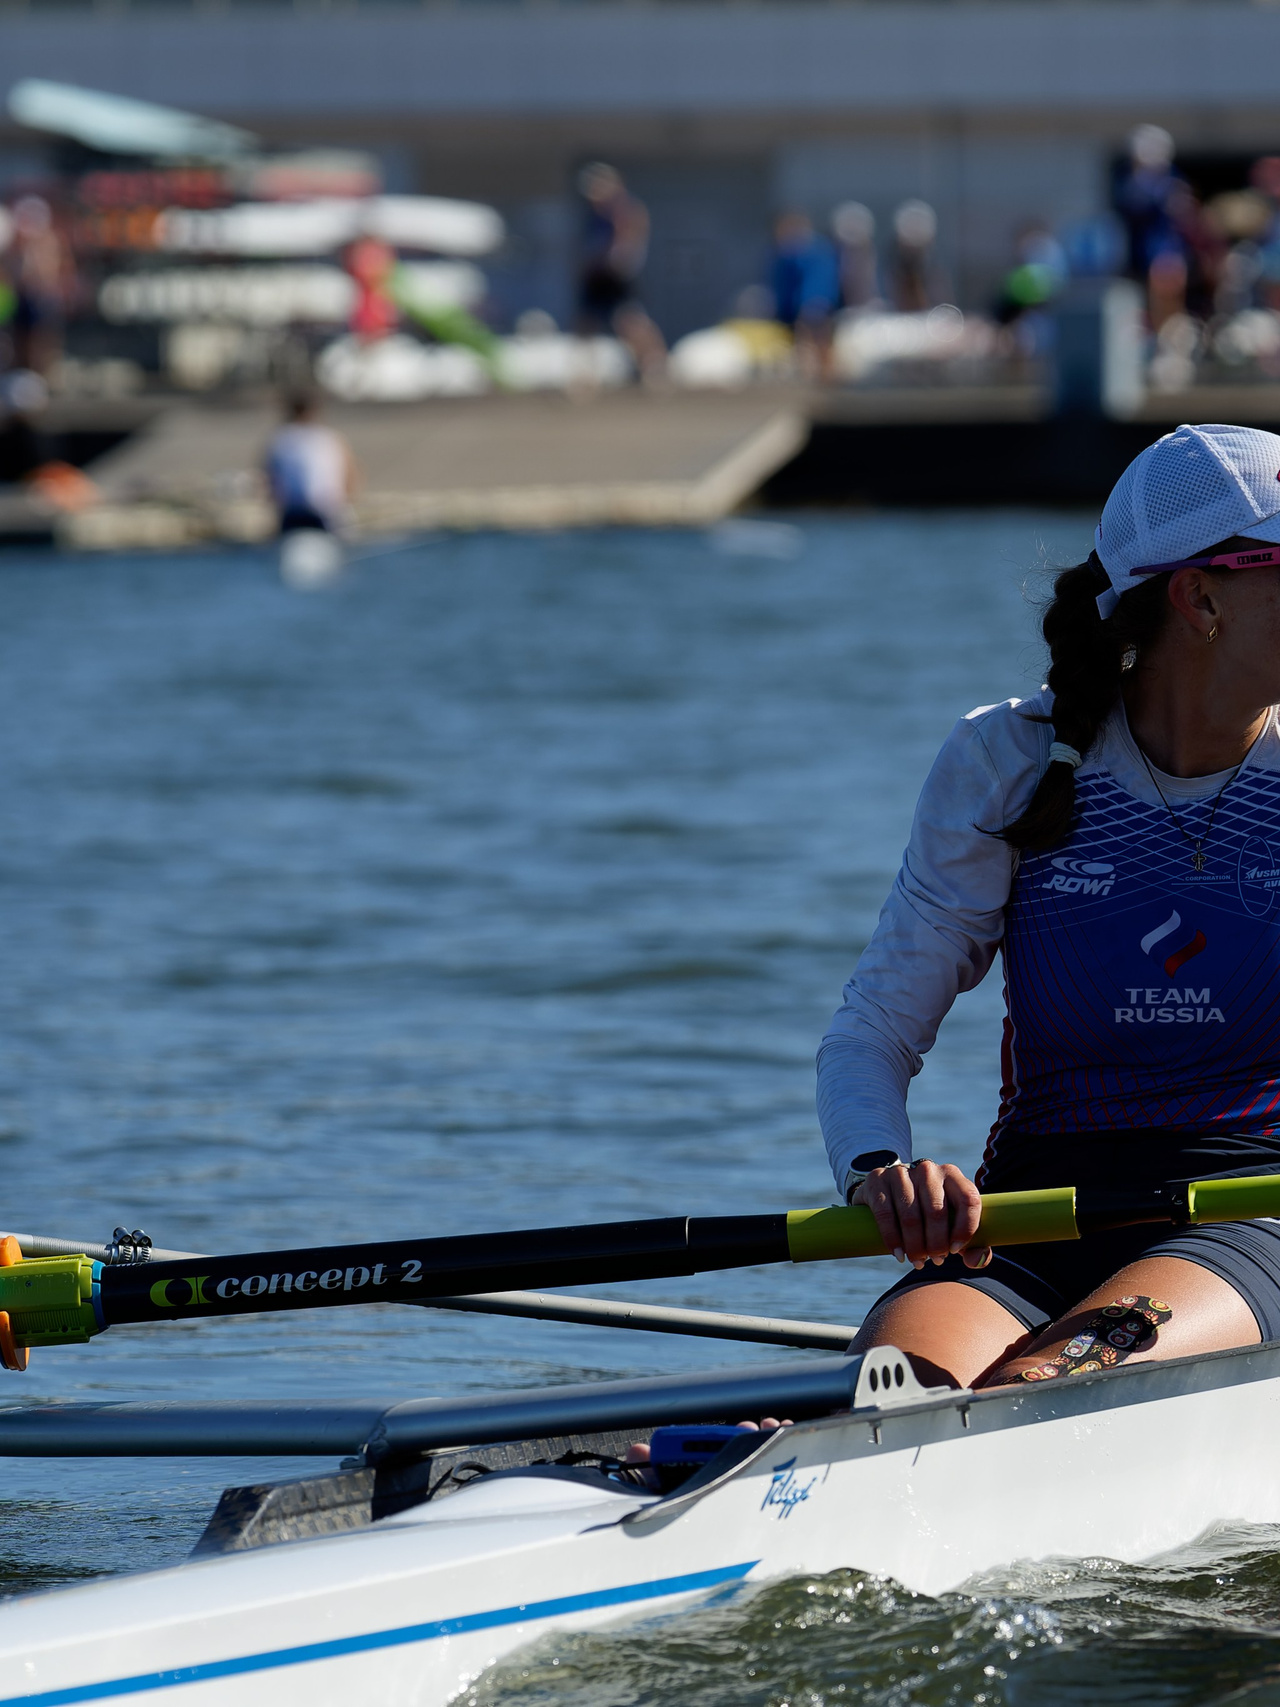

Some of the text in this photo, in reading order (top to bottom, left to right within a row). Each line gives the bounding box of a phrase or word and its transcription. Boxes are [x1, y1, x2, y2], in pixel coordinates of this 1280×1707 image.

[1125, 988, 1210, 1004] TEAM
[1114, 1007, 1226, 1023] RUSSIA
[216, 1259, 423, 1299] concept 2
